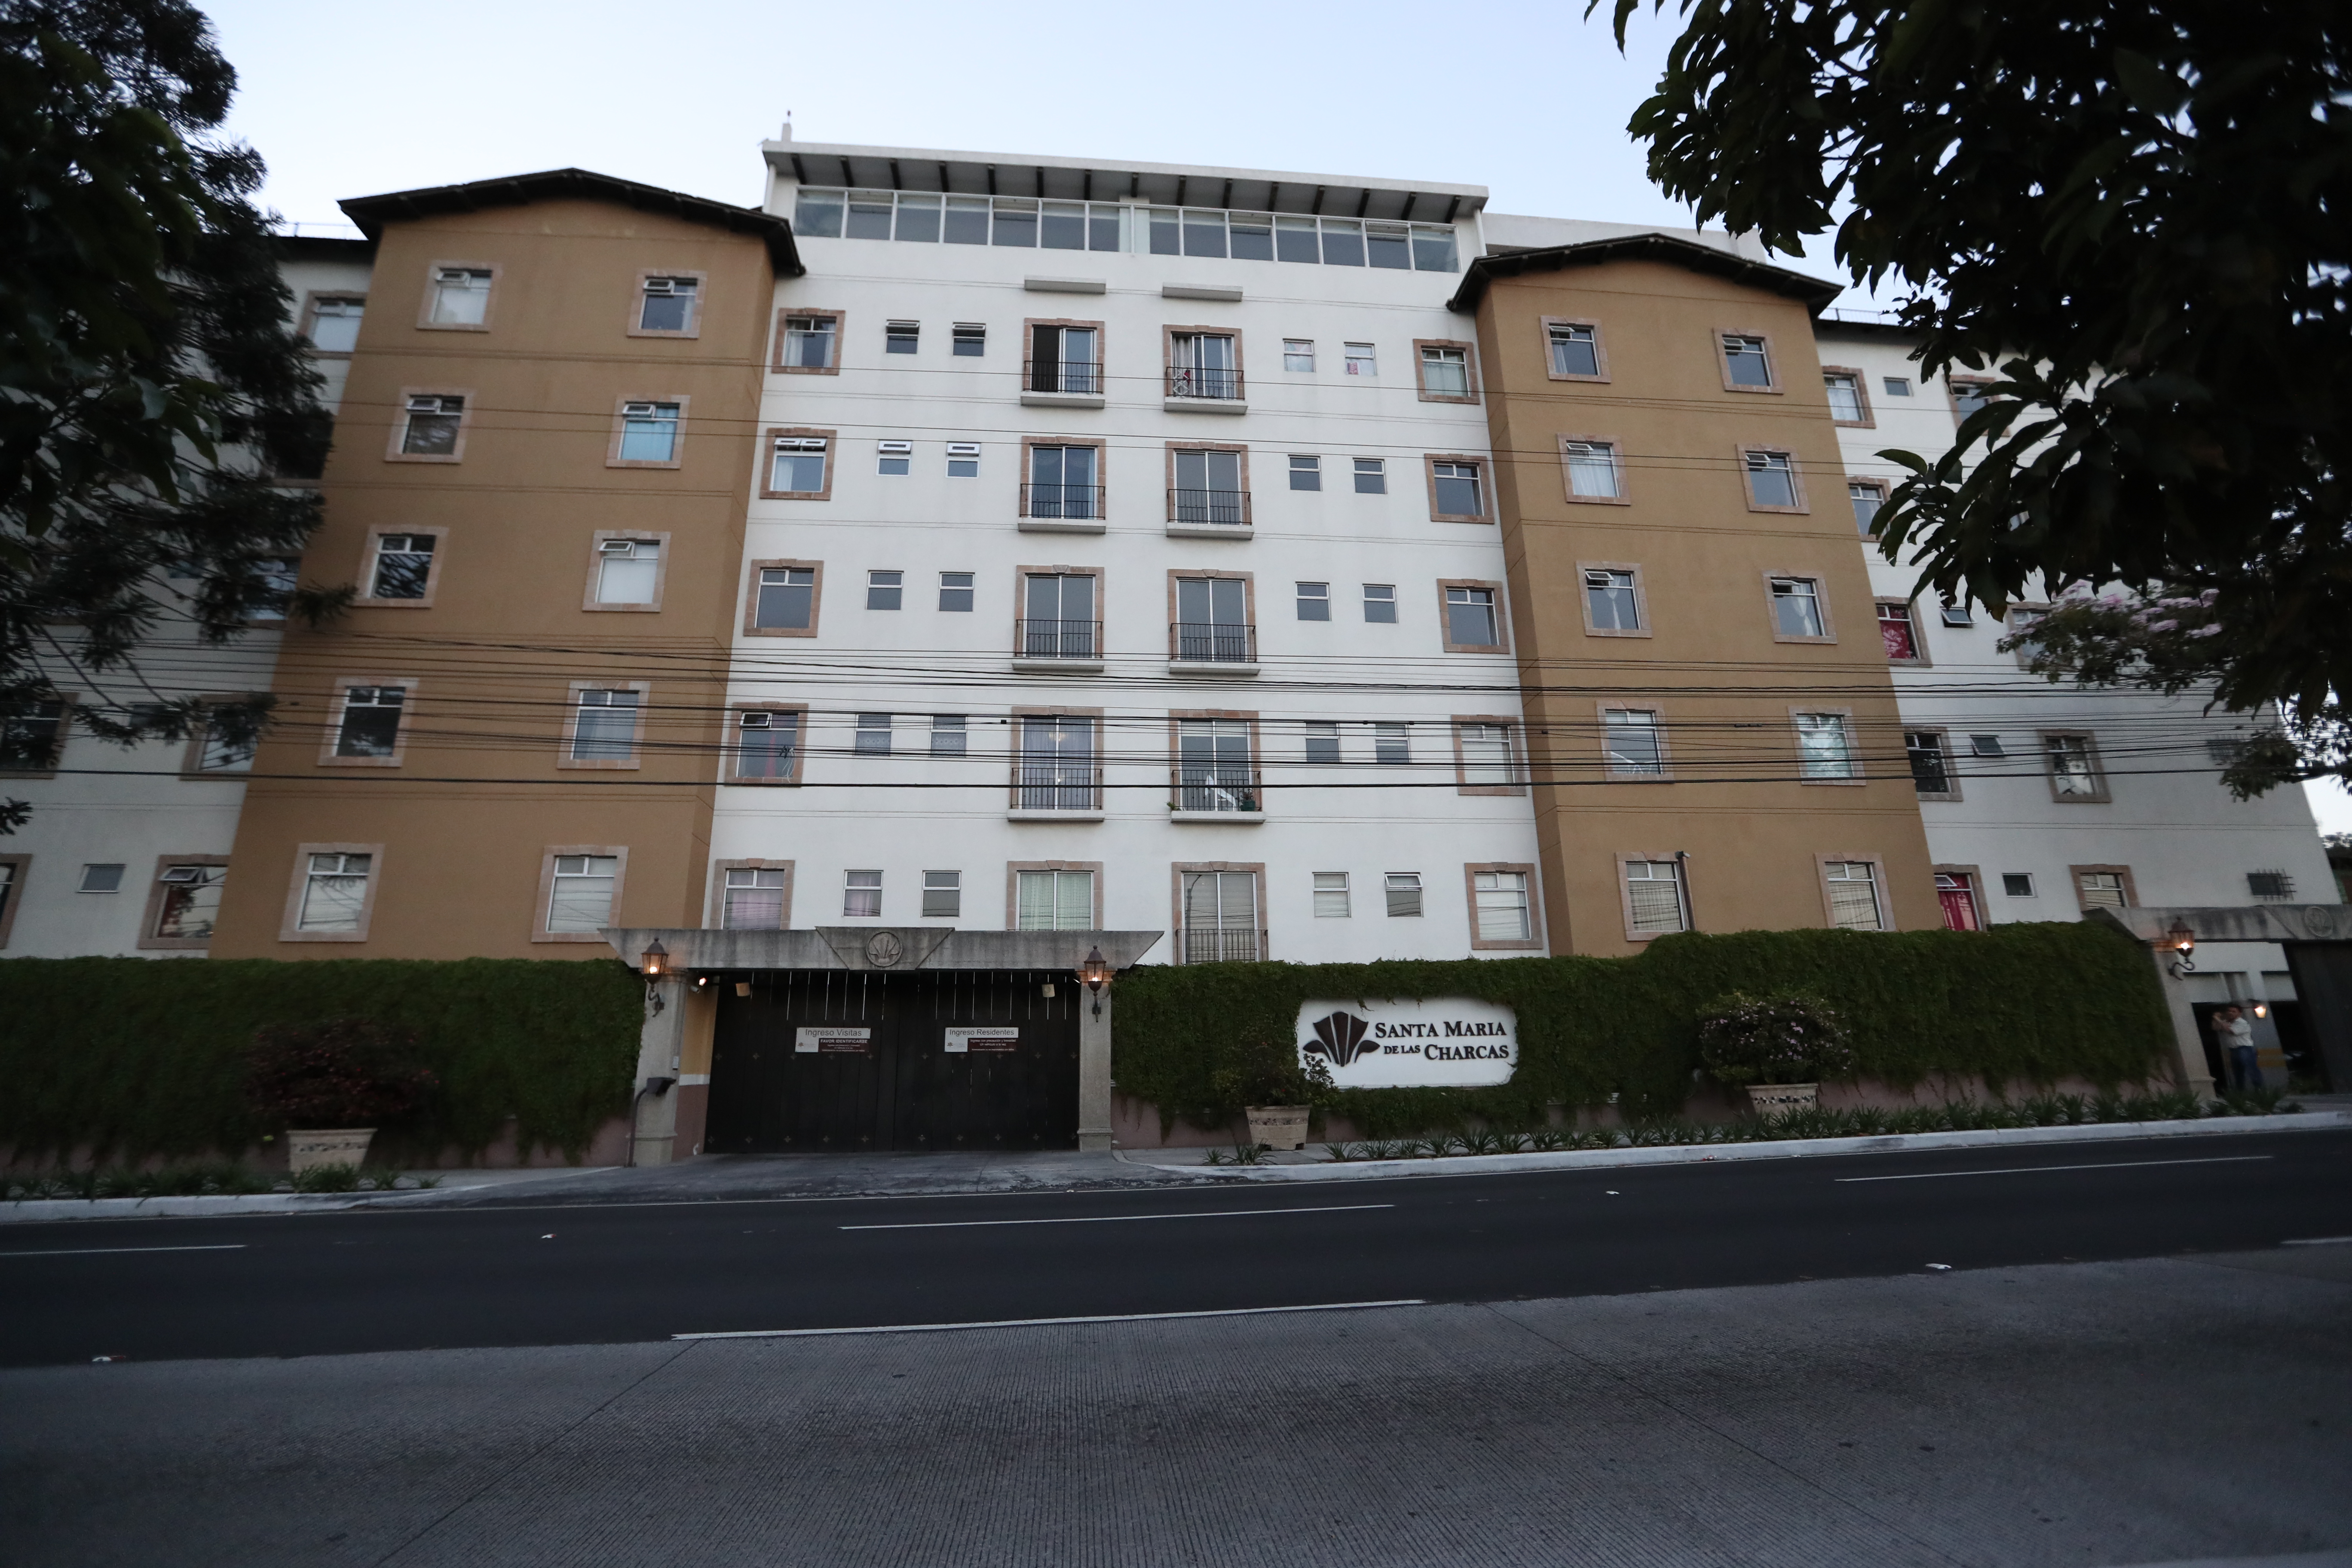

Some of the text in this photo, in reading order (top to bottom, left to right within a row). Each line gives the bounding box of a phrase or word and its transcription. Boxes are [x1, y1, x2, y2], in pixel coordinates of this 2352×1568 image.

[805, 1029, 834, 1037] Ingreso
[1375, 1021, 1507, 1038] SANTA MARIA
[1384, 1044, 1510, 1061] DE LAS CHARCAS
